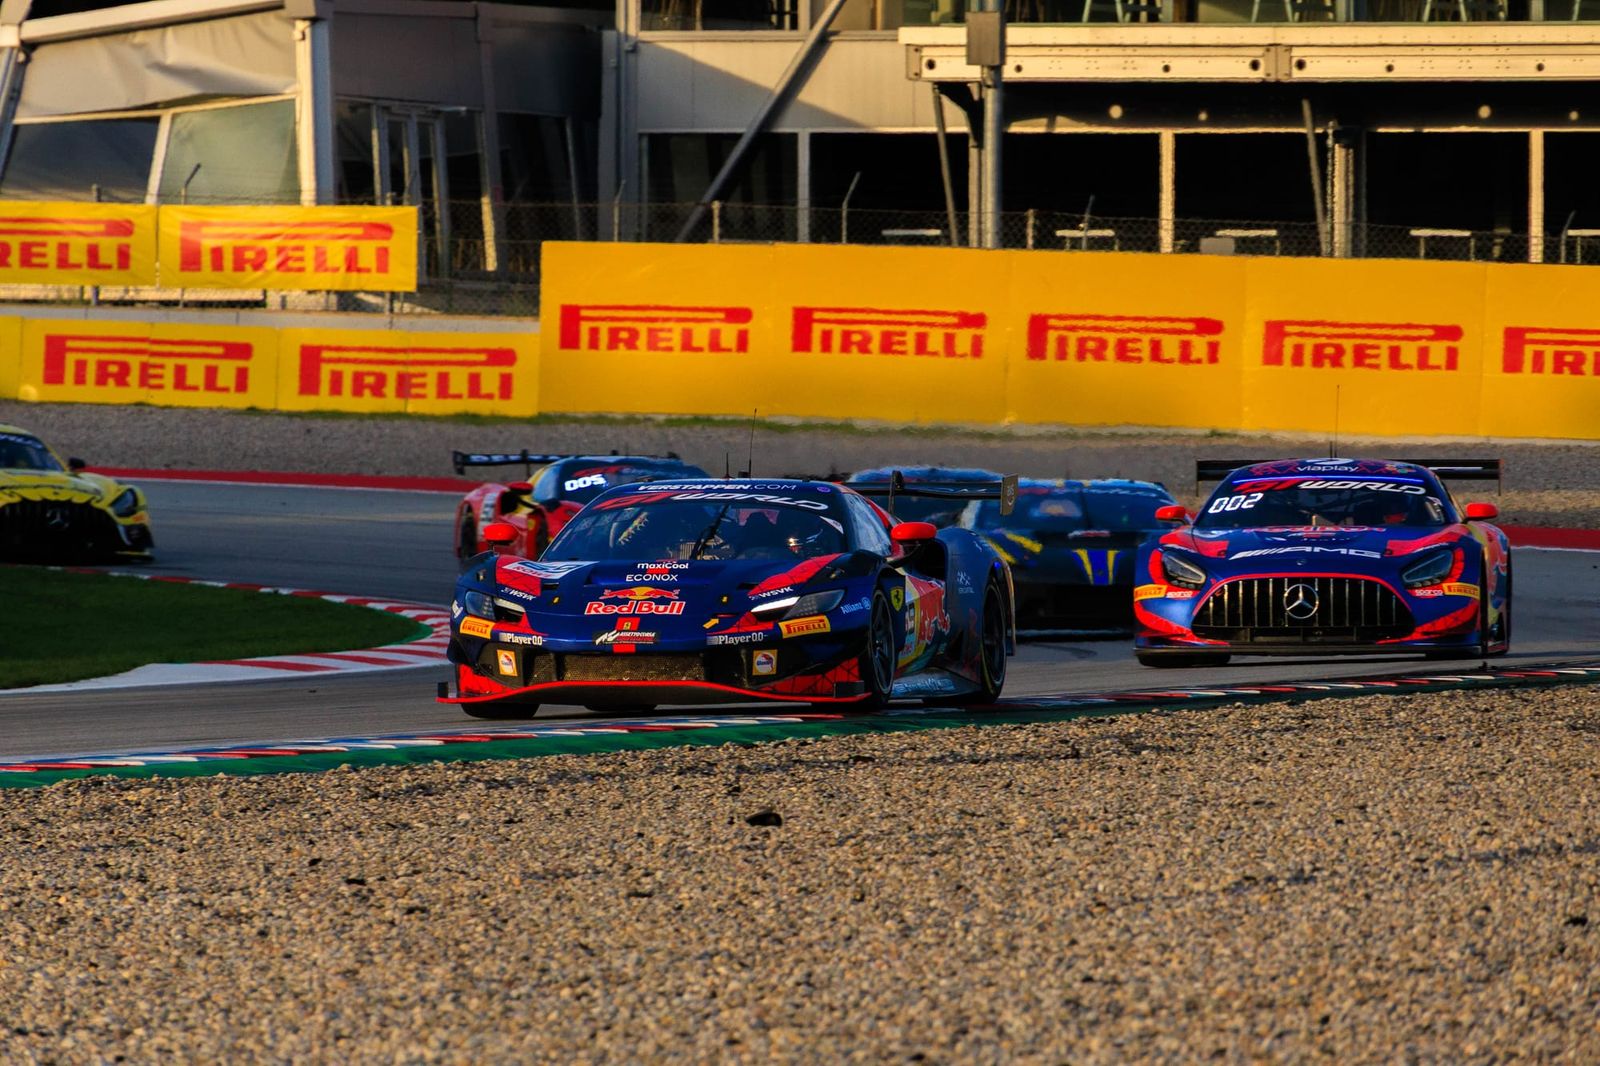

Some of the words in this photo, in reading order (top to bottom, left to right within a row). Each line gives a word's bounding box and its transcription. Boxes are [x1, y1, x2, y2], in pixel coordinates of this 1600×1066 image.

[180, 221, 394, 274] PIRELLI
[559, 303, 753, 354] PIRELLI
[791, 306, 987, 359] PIRELLI
[1026, 313, 1225, 366] PIRELLI
[1263, 319, 1465, 371] PIRELLI
[1503, 327, 1600, 376] PIR
[43, 334, 254, 394] PIRELLI
[298, 344, 518, 401] PIRELLI
[1297, 465, 1359, 474] viaplay
[638, 483, 798, 491] VERSTAPPEN.COM
[1233, 478, 1322, 493] GT
[1299, 480, 1427, 495] WORLD
[670, 492, 829, 511] WORLD
[1208, 492, 1264, 514] 002
[1281, 546, 1381, 559] AMG
[637, 561, 689, 569] maxiCool
[625, 573, 679, 582] ECONOX
[510, 589, 537, 601] WSVK
[758, 586, 794, 598] WSVK
[584, 600, 637, 615] Red
[634, 600, 686, 615] Bull
[786, 618, 827, 634] PIRELLI
[507, 633, 532, 646] Player
[718, 634, 751, 646] Player
